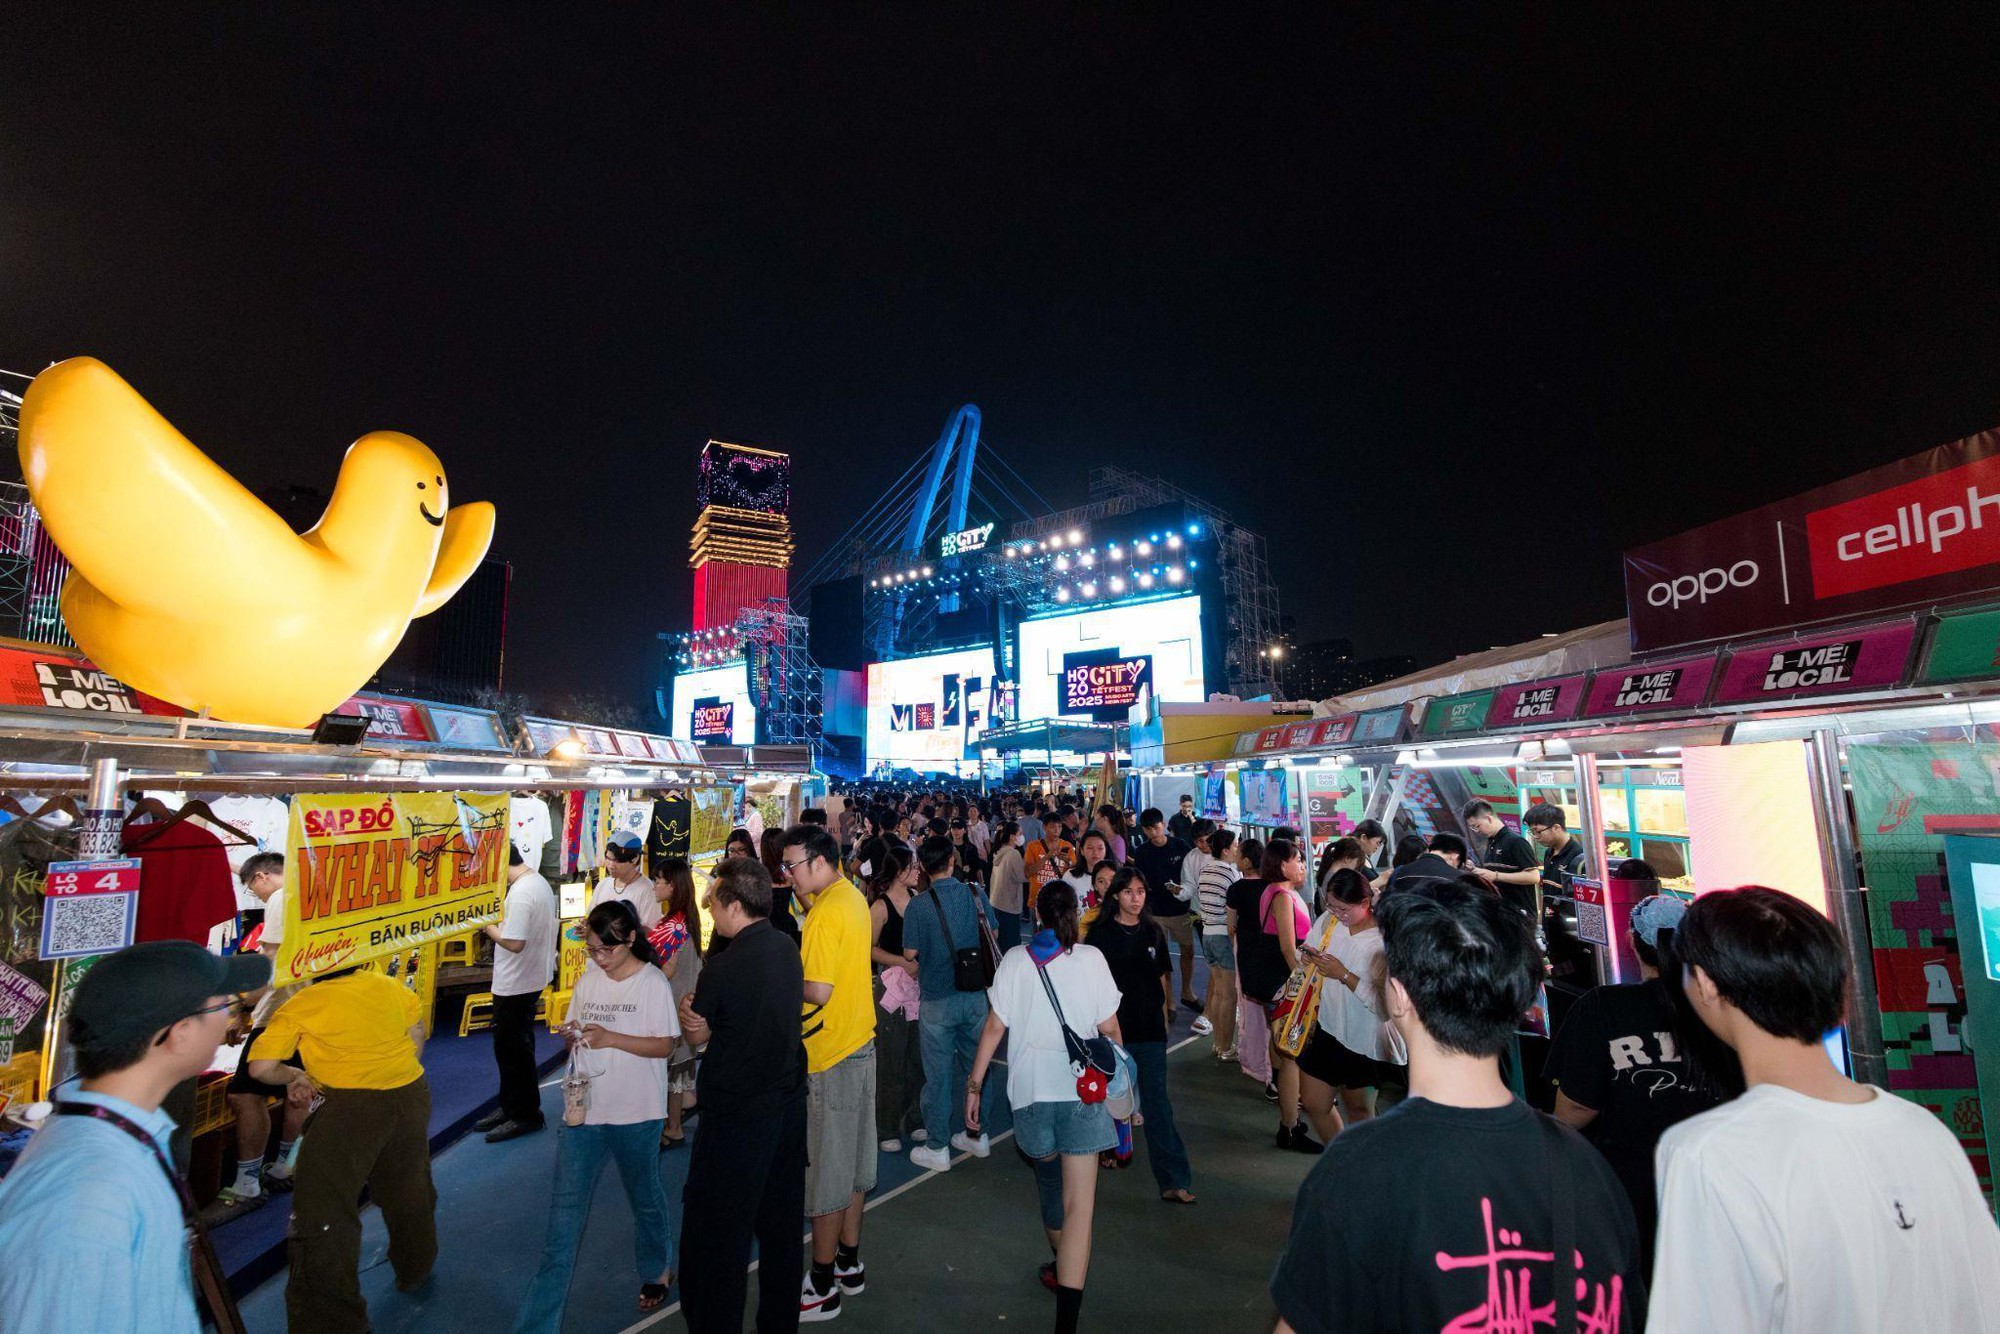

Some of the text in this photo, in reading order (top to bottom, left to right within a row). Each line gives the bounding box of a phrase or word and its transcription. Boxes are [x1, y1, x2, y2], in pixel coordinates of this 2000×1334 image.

[1647, 560, 1759, 609] oppo
[1762, 665, 1851, 691] LOCAL
[41, 686, 143, 714] LOCAL
[1067, 696, 1104, 708] 2025
[1614, 688, 1673, 707] LOCAL
[1513, 703, 1554, 719] LOCAL
[1653, 771, 1680, 785] Neat
[95, 872, 121, 890] 4
[298, 837, 411, 921] WHAT
[1589, 889, 1598, 902] 7
